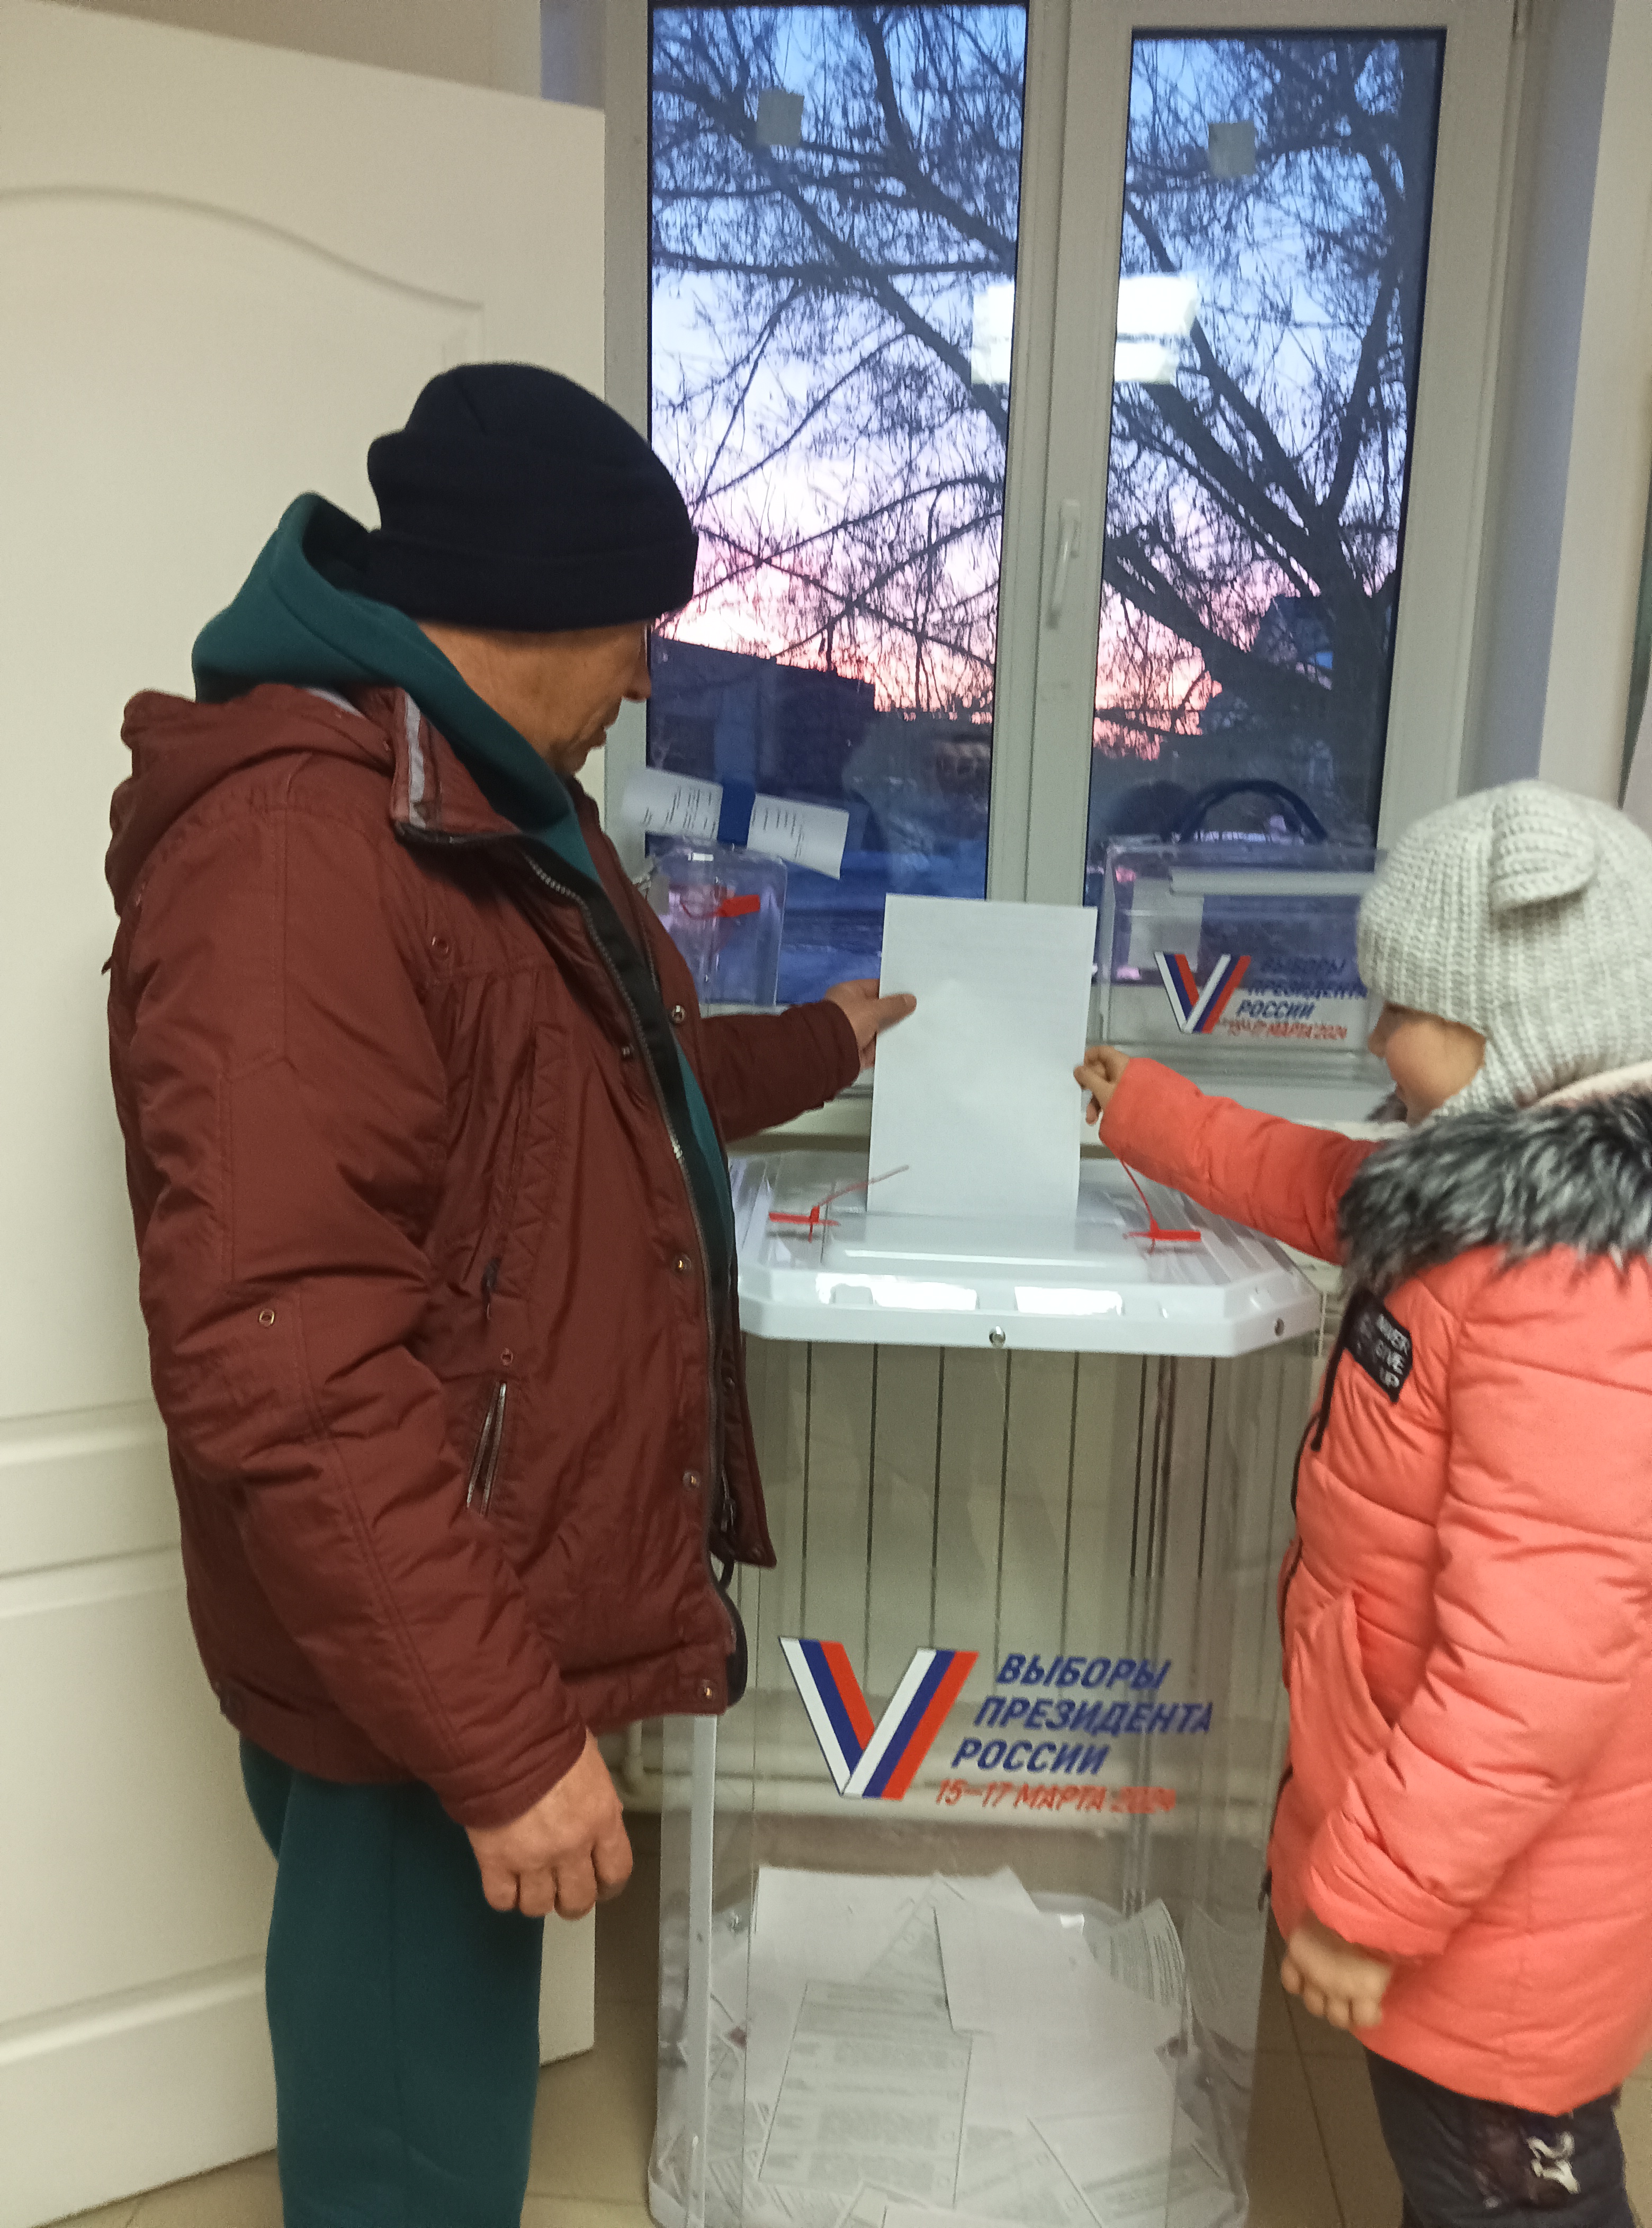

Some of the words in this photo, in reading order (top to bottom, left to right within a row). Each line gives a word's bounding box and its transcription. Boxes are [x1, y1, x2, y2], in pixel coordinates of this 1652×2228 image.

[1236, 999, 1316, 1019] РОССИИ
[996, 1653, 1172, 1690] ВЫБОРЫ
[973, 1695, 1214, 1737] ПРЕЗИДЕНТА
[951, 1737, 1111, 1775] РОССИИ
[1012, 1783, 1107, 1813] МАРТА
